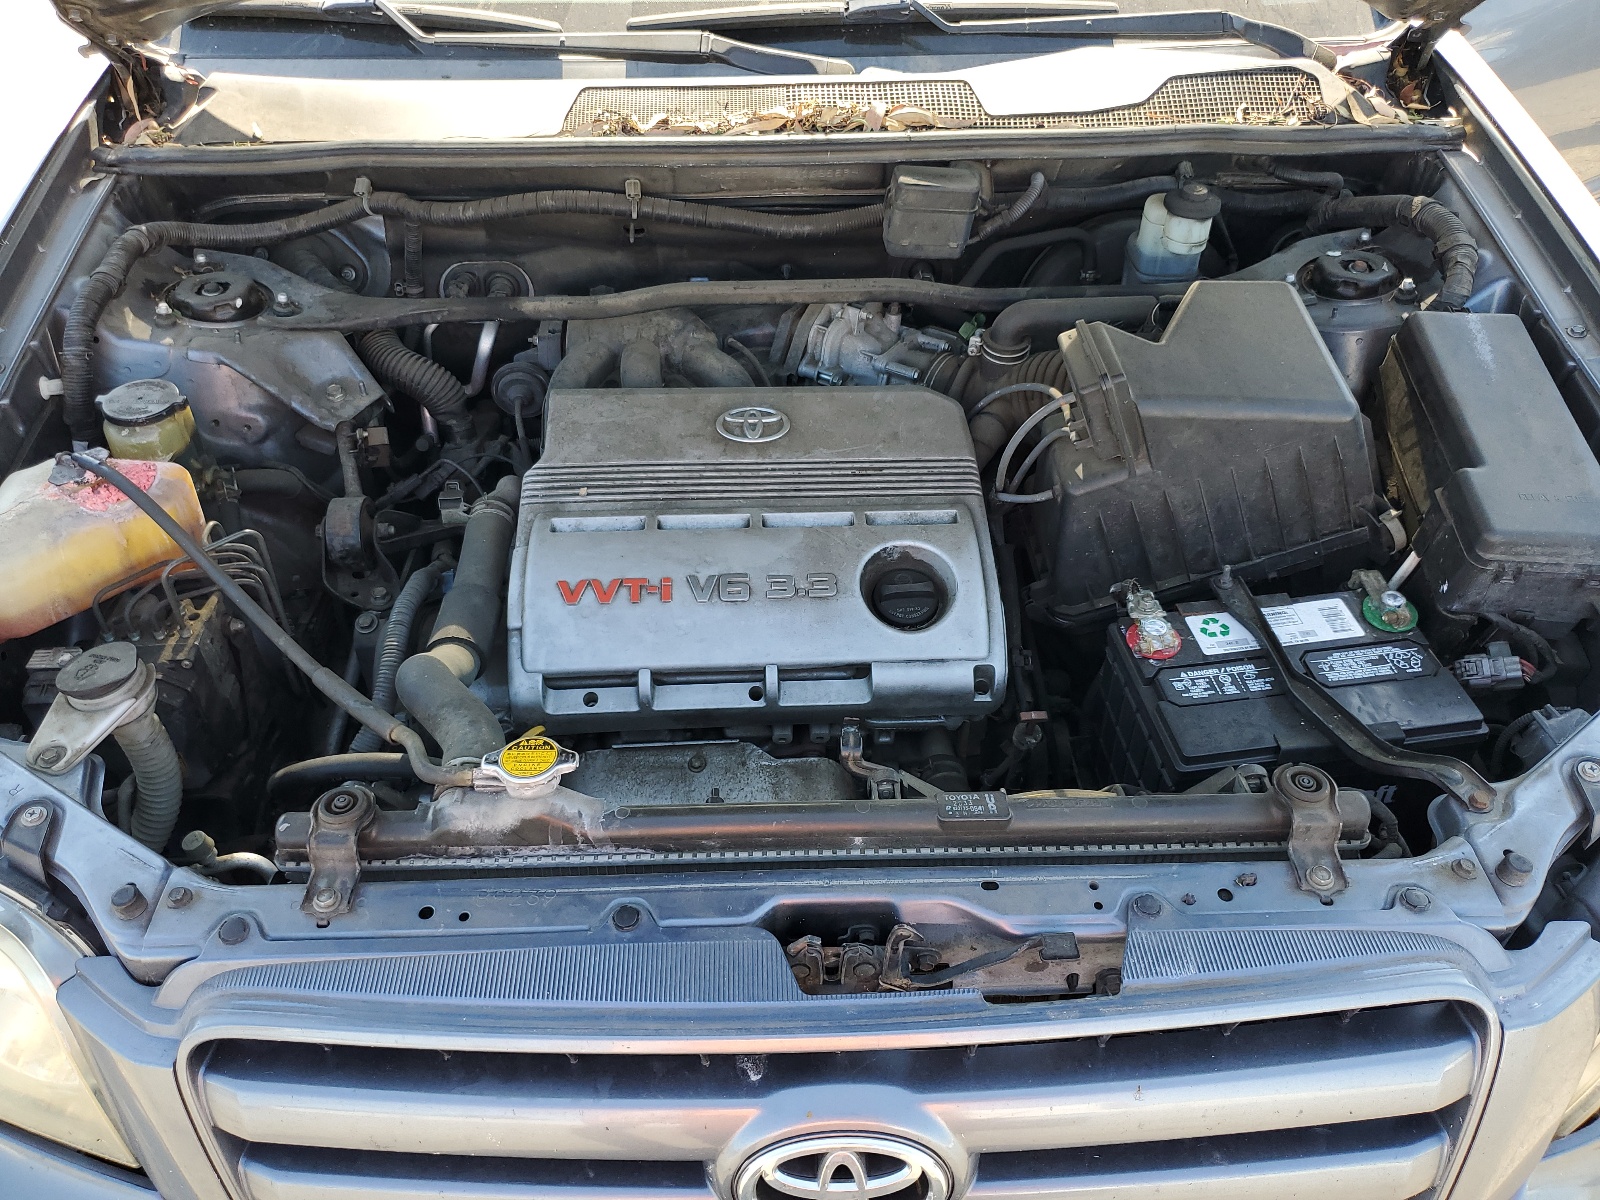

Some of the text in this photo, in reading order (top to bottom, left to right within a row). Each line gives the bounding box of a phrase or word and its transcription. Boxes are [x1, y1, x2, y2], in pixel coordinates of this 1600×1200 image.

[556, 572, 838, 605] VVT-i V6 3.3
[1187, 668, 1219, 677] DANGER
[1226, 664, 1255, 672] POISON
